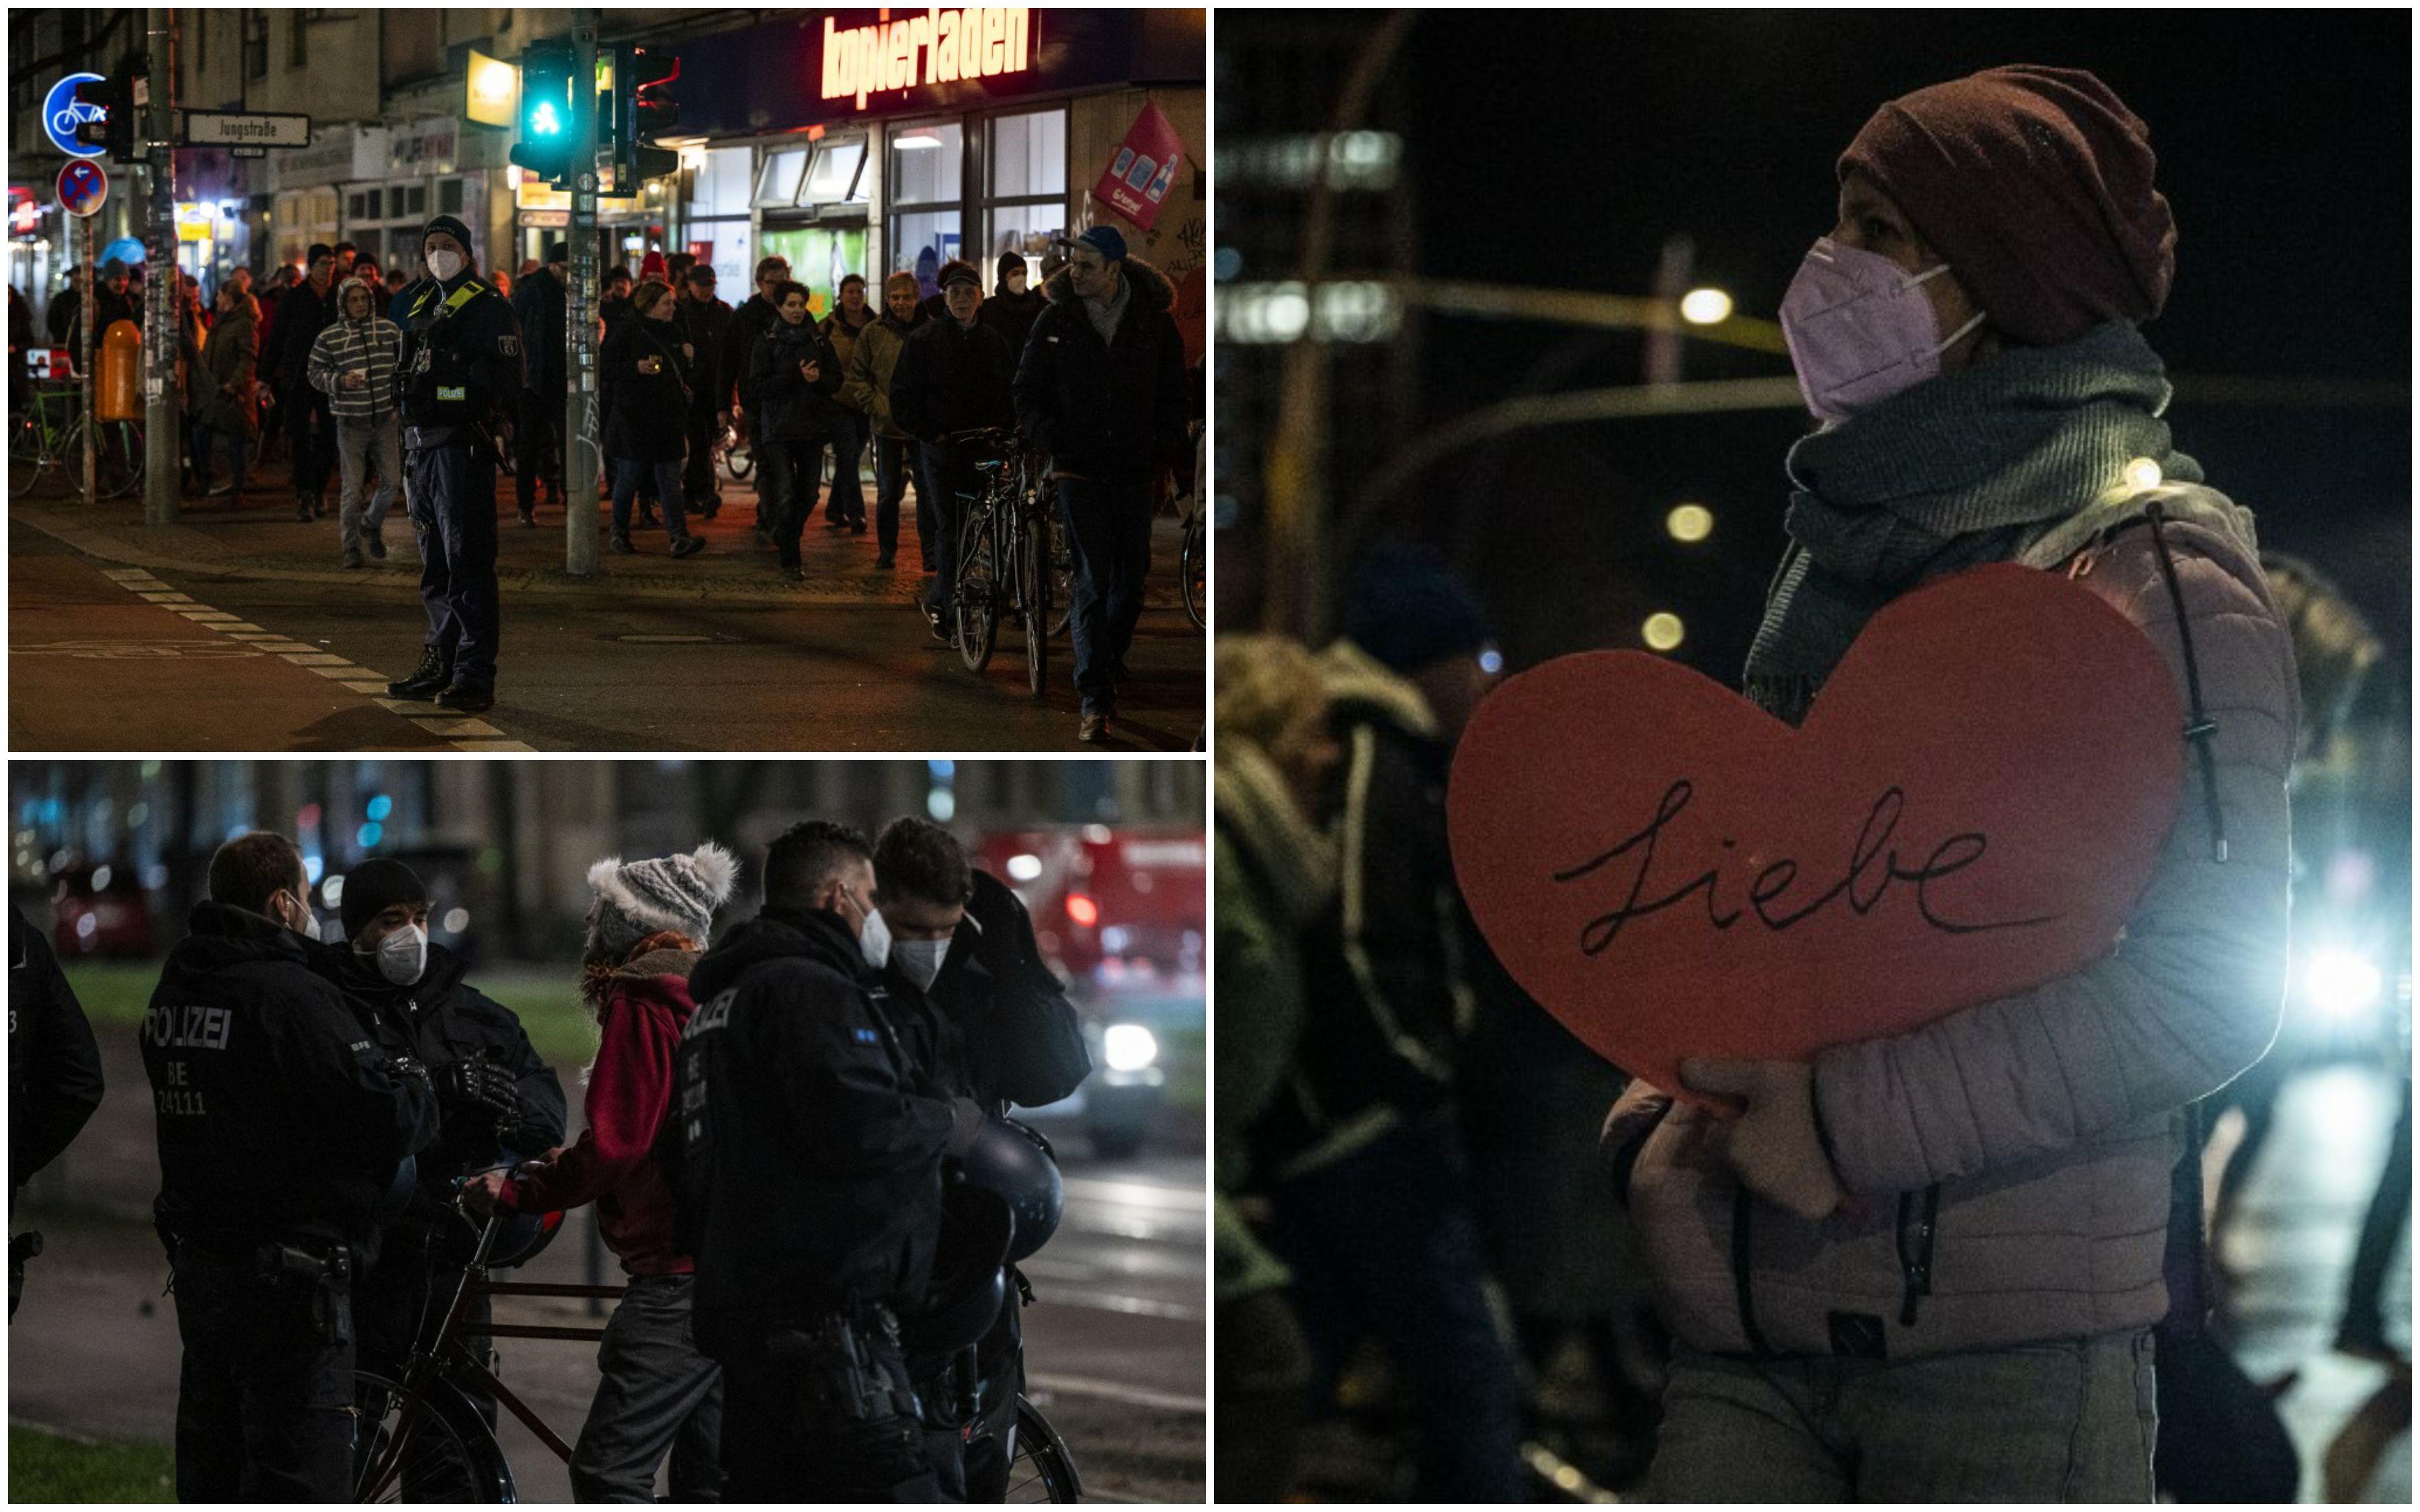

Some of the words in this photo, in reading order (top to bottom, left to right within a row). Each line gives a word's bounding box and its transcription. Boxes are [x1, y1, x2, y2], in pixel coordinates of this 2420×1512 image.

[821, 8, 1028, 110] kopierladen
[220, 120, 276, 140] Jungstraße
[426, 224, 456, 235] POLIZEI
[438, 388, 465, 398] POLIZEI
[1554, 779, 2064, 956] Liebe
[145, 1005, 232, 1050] POLIZEI
[167, 1062, 188, 1085] BE
